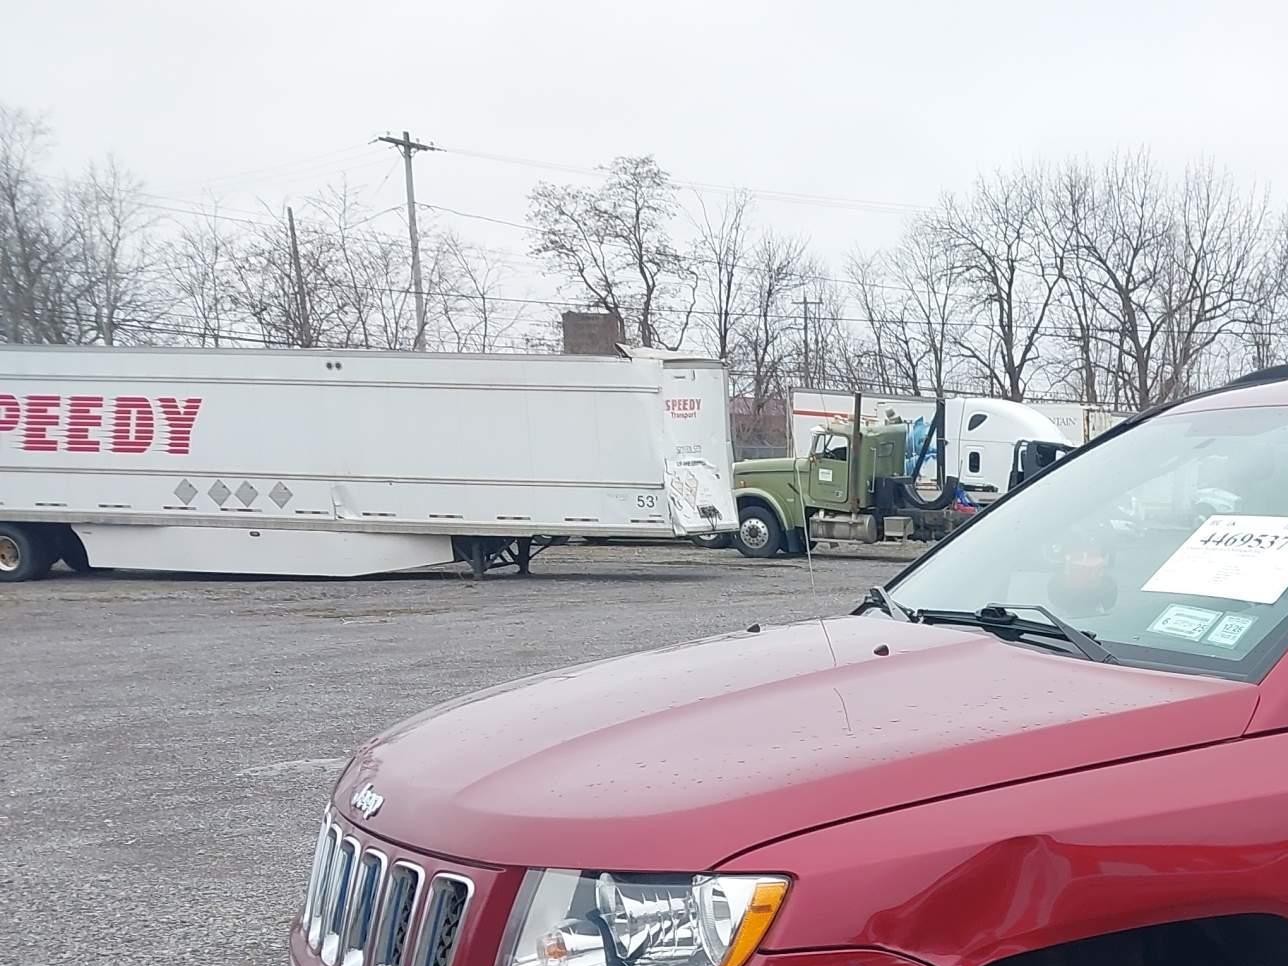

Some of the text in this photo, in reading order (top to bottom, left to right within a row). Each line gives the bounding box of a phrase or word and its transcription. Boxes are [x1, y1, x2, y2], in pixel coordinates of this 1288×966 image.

[665, 399, 701, 411] SPEEDY
[670, 411, 697, 419] Transport
[351, 782, 385, 820] Jeep
